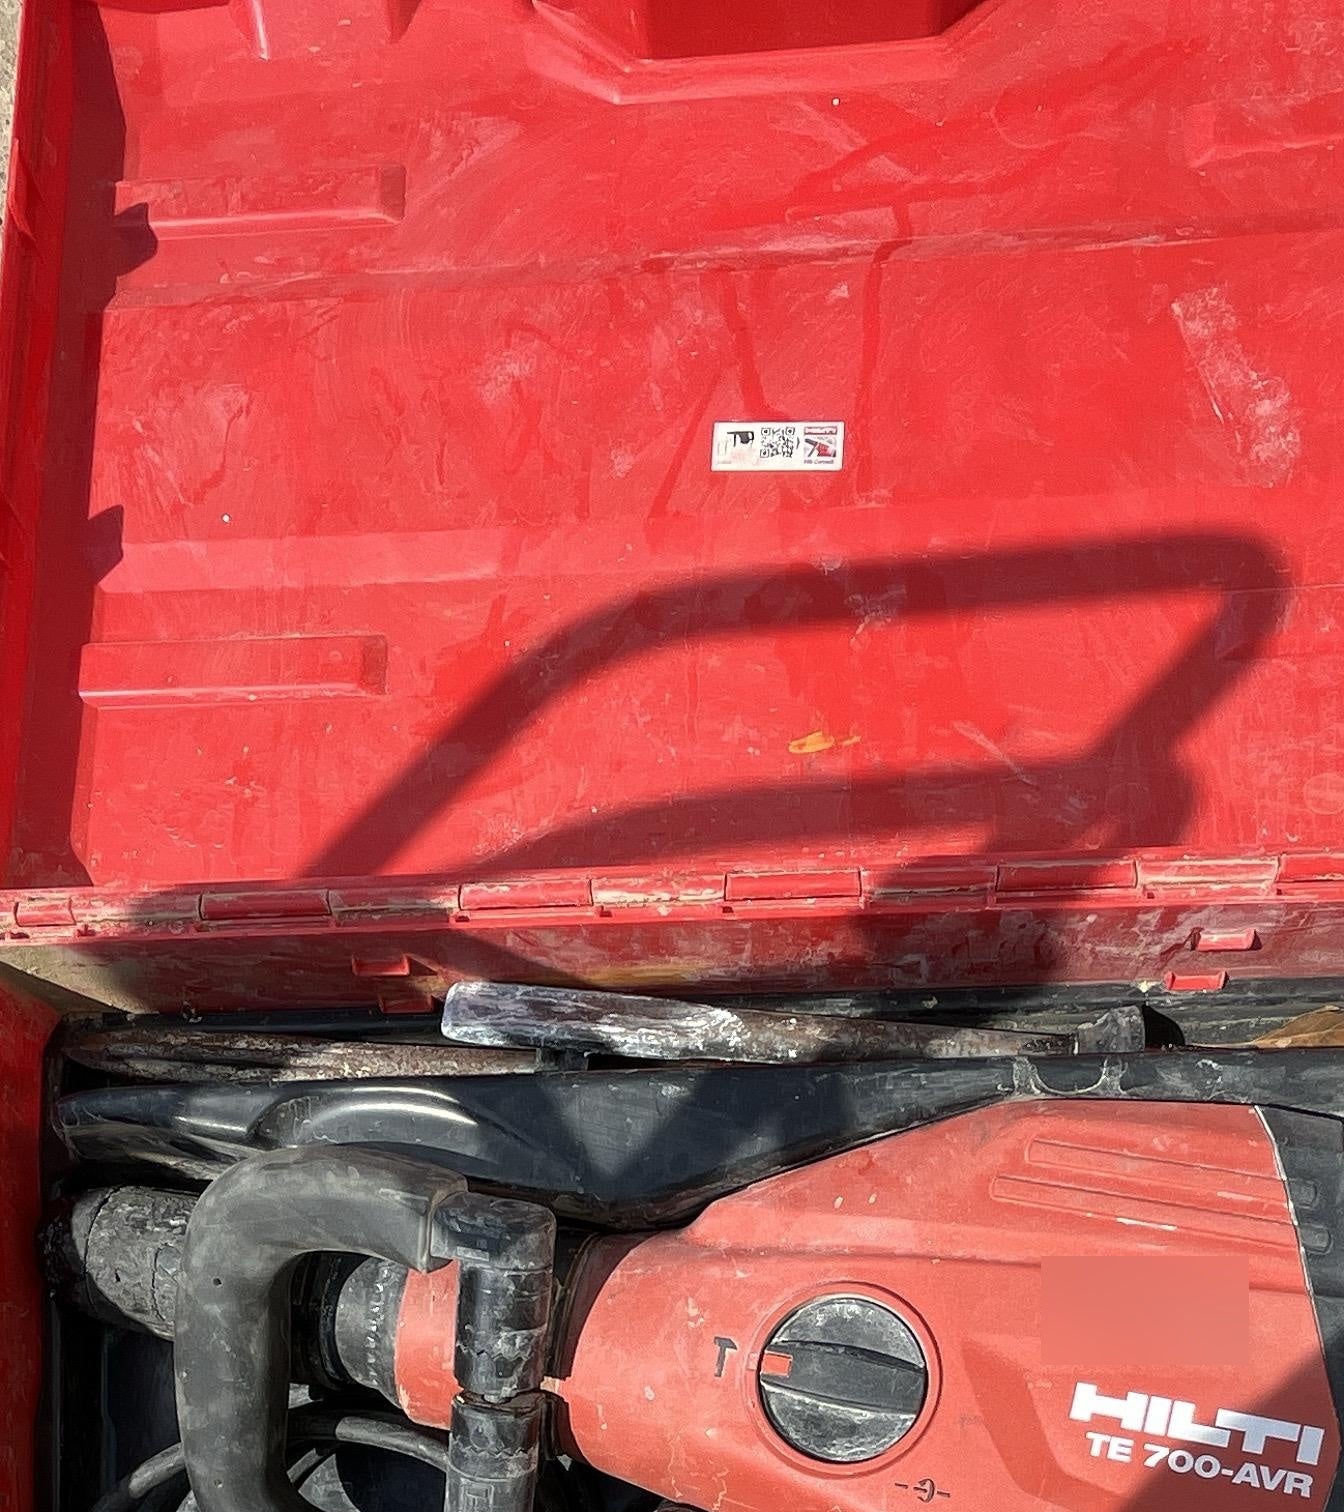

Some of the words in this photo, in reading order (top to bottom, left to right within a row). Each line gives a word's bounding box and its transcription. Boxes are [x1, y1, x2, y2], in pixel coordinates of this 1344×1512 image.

[1068, 1381, 1325, 1466] HILTI
[1085, 1431, 1135, 1463] TE
[1143, 1443, 1313, 1498] 700-AVR
